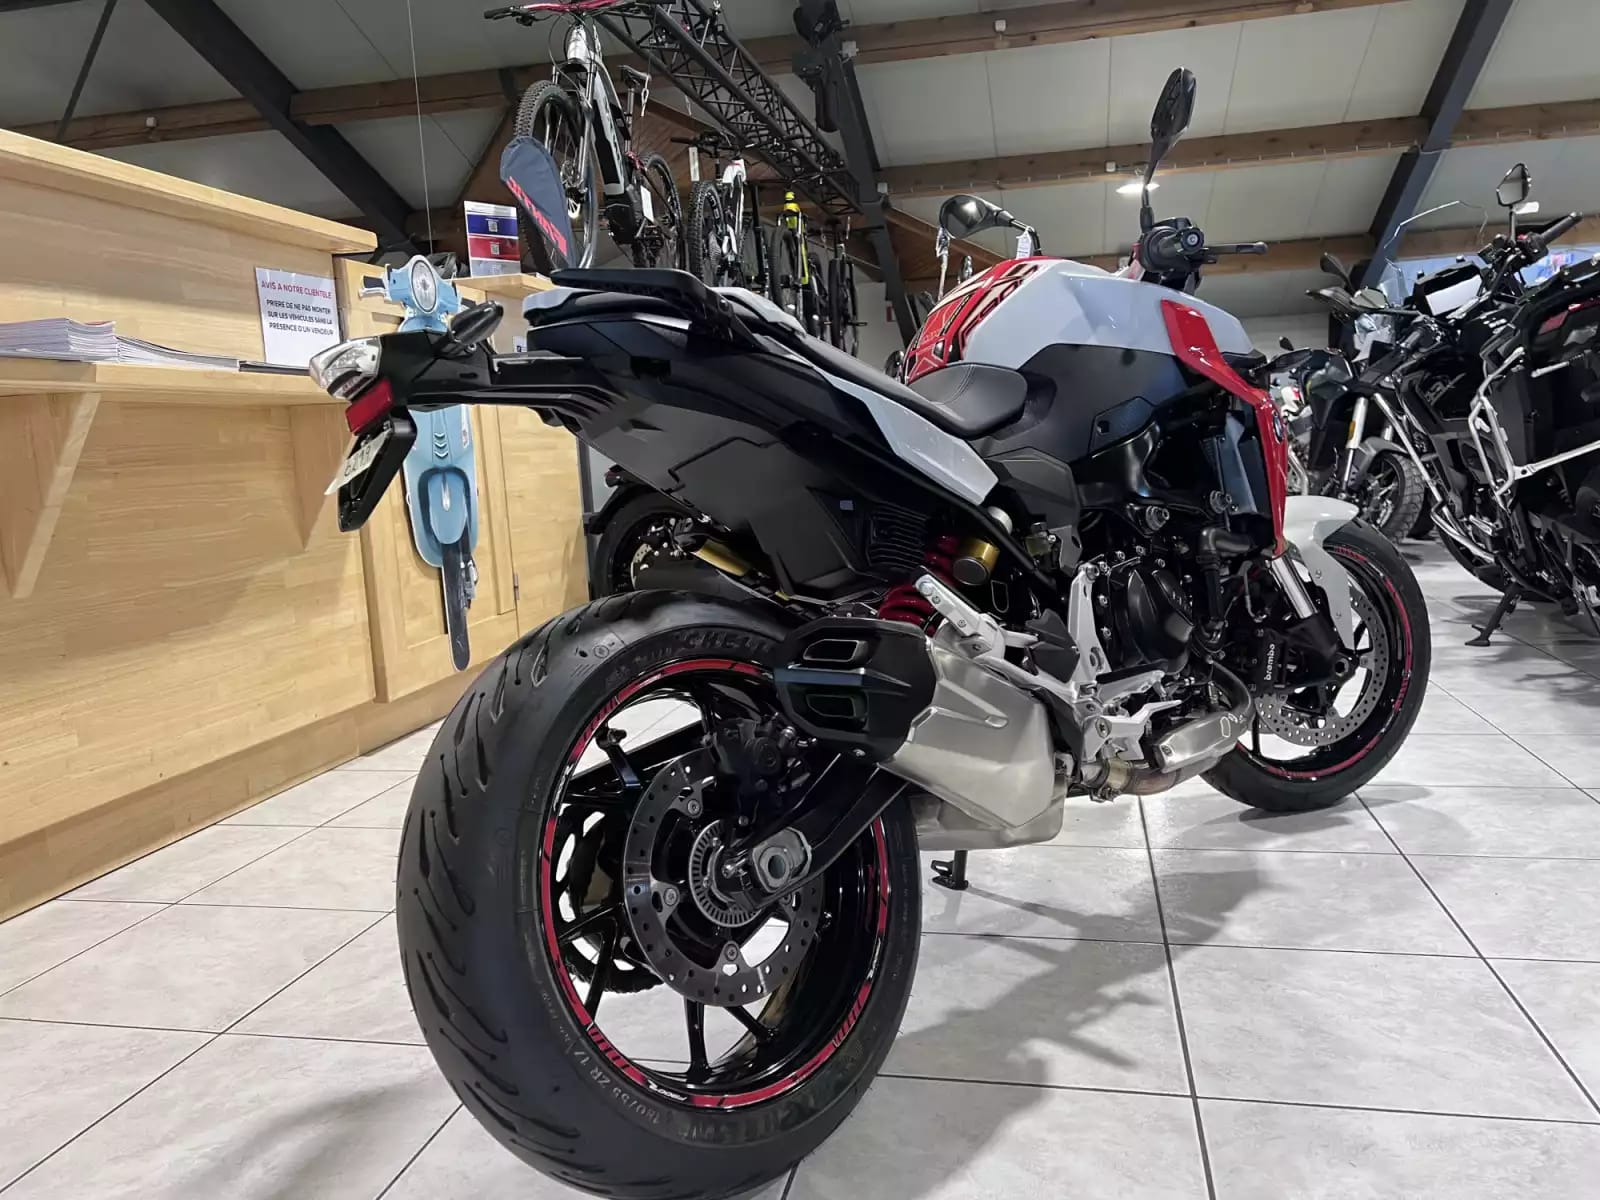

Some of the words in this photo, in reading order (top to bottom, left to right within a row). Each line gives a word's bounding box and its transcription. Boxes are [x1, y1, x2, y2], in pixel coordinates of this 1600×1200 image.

[261, 280, 276, 290] AVIS
[283, 284, 304, 295] NOTRE
[294, 303, 301, 311] NE
[302, 304, 311, 312] PAS
[311, 306, 331, 315] MONTER
[267, 310, 278, 318] SUR
[314, 317, 326, 325] SANS
[297, 325, 311, 333] D'UN
[311, 327, 334, 336] VENDEUR
[1263, 643, 1276, 681] brembo
[590, 1065, 611, 1084] ZR
